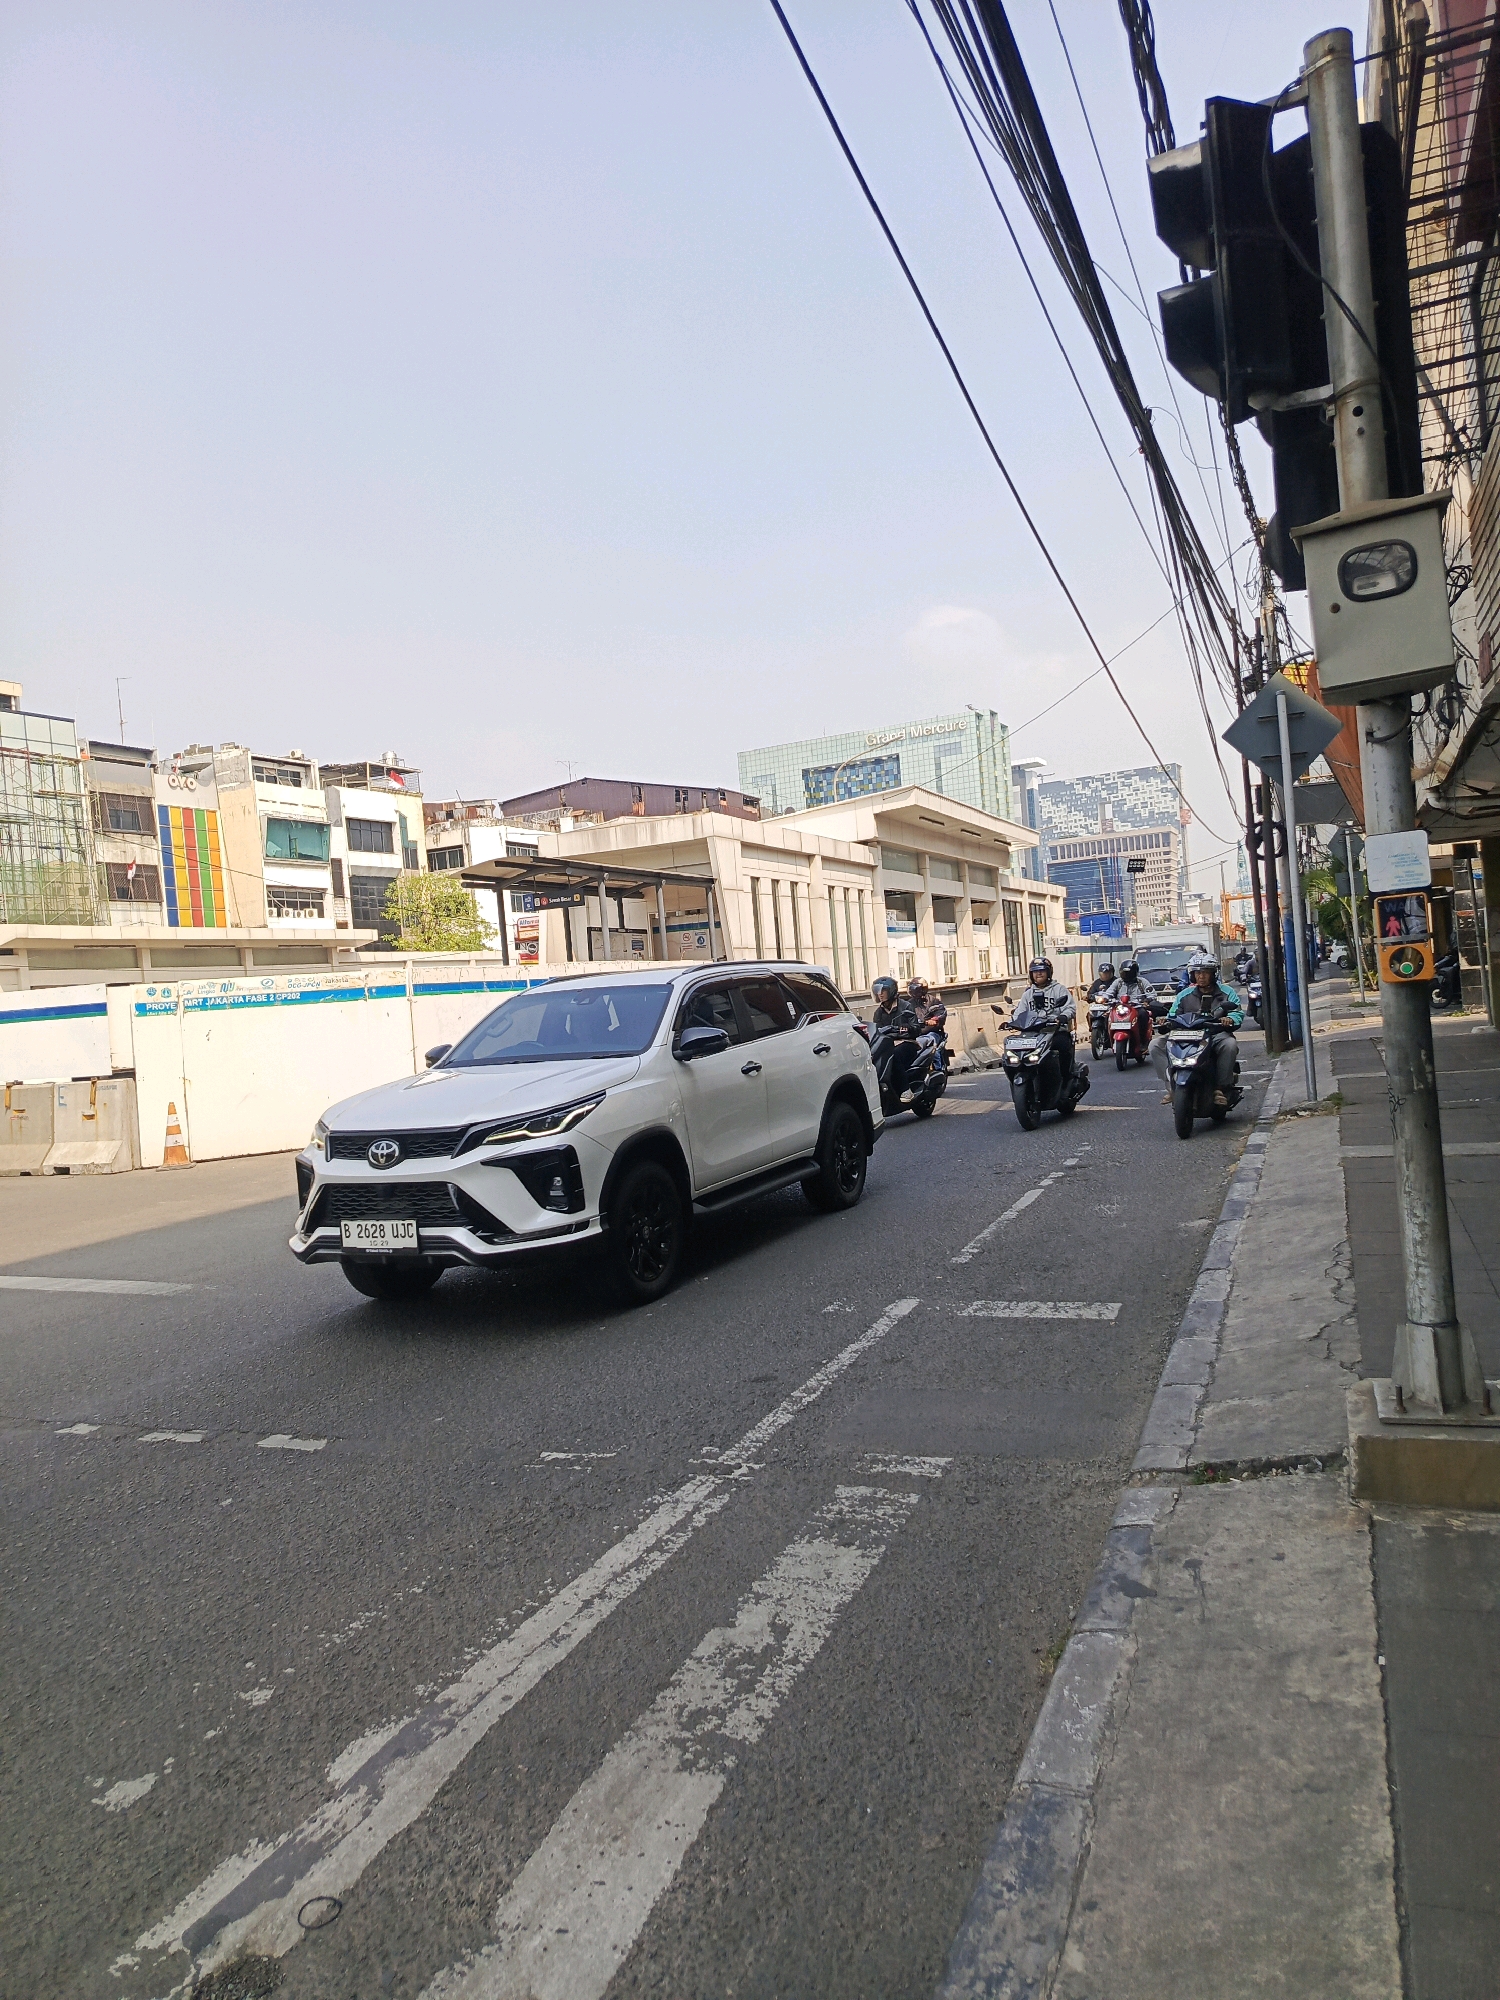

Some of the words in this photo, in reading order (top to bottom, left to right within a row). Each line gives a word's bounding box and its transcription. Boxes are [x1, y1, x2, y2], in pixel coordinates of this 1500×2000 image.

[865, 728, 906, 746] Grand
[910, 719, 967, 738] Mercure
[168, 773, 197, 790] OYO
[146, 1002, 177, 1010] PROYE
[184, 998, 204, 1007] MRT
[205, 995, 245, 1006] JAKARTA
[246, 994, 268, 1003] FASE
[276, 992, 301, 1001] CP202
[344, 1223, 351, 1238] B
[356, 1223, 386, 1238] 2628
[391, 1223, 414, 1238] UJC
